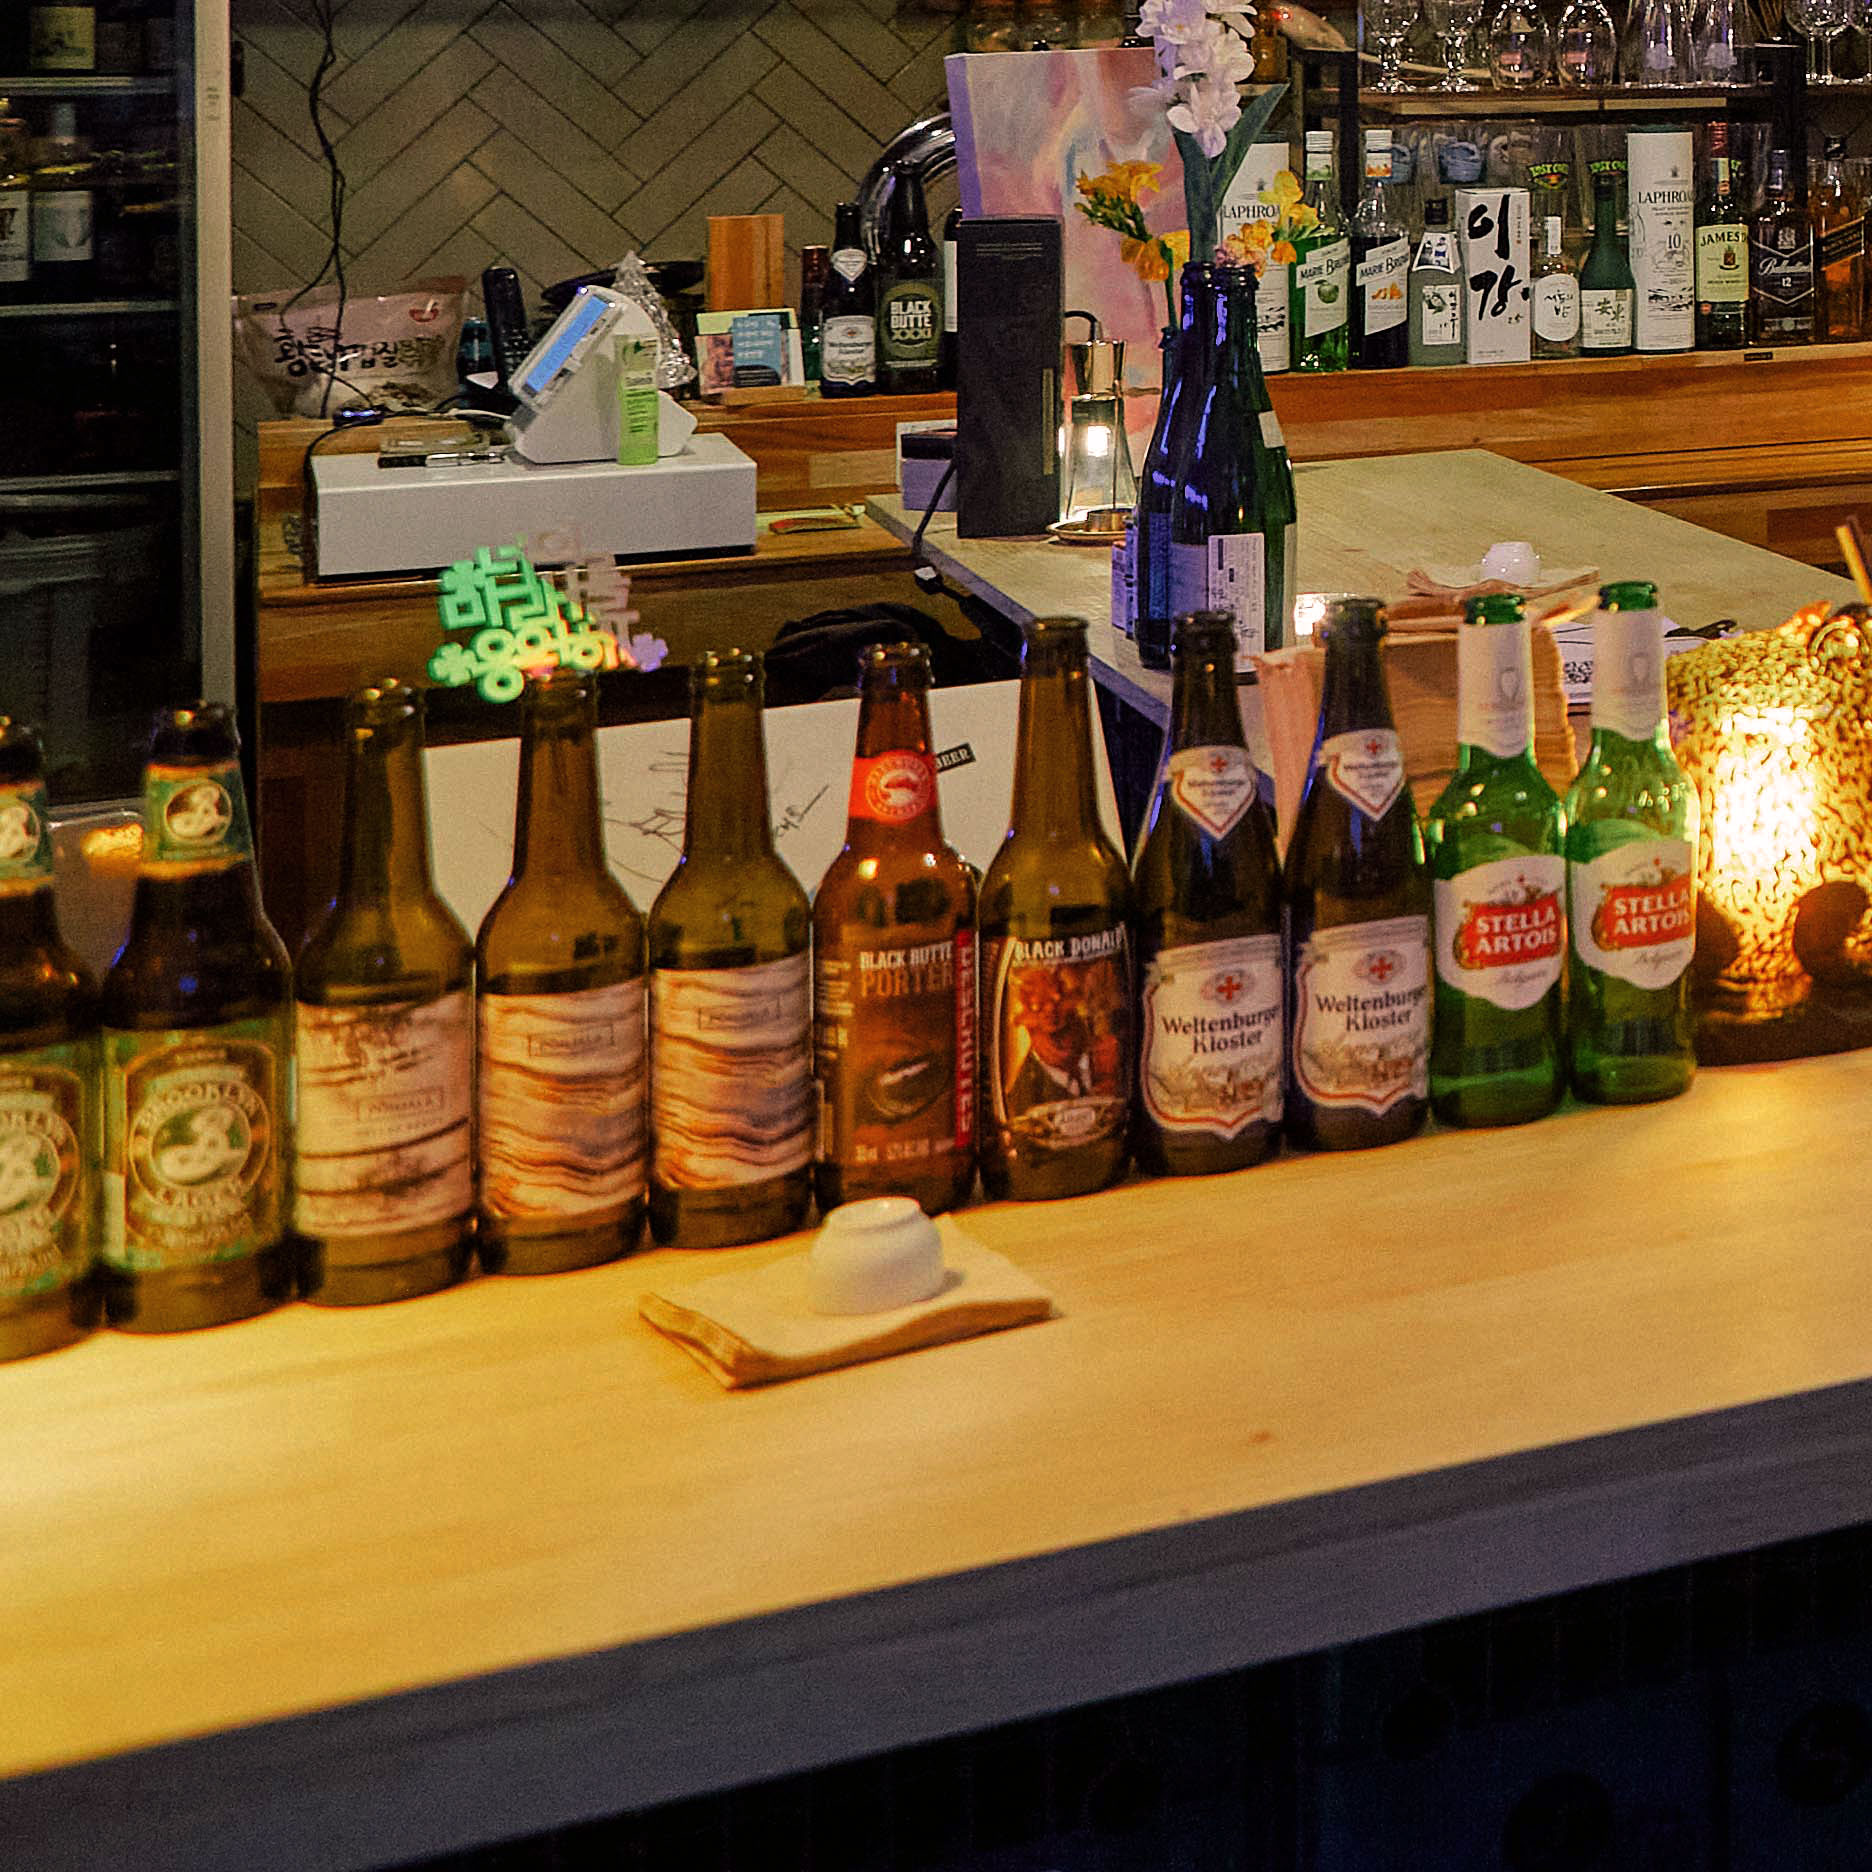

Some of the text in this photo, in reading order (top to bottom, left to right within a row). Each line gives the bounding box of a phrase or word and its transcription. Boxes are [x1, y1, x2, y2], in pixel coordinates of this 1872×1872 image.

[1637, 190, 1694, 206] LAPHROA
[1666, 234, 1682, 250] 10
[1298, 259, 1325, 280] MARIE
[1358, 260, 1387, 279] MARIE
[1780, 276, 1793, 288] 12
[889, 298, 932, 316] BLACK
[889, 314, 932, 331] BUTTE
[890, 329, 932, 343] XXXI
[1614, 889, 1691, 919] STELLA
[1475, 907, 1558, 935] STELLA
[1012, 935, 1065, 963] BLACK
[1473, 928, 1558, 956] ARTOIS
[859, 946, 905, 969] BLACK
[860, 965, 956, 999] PORTER
[1345, 1007, 1414, 1034] Kloster
[1191, 1029, 1264, 1055] Kloster
